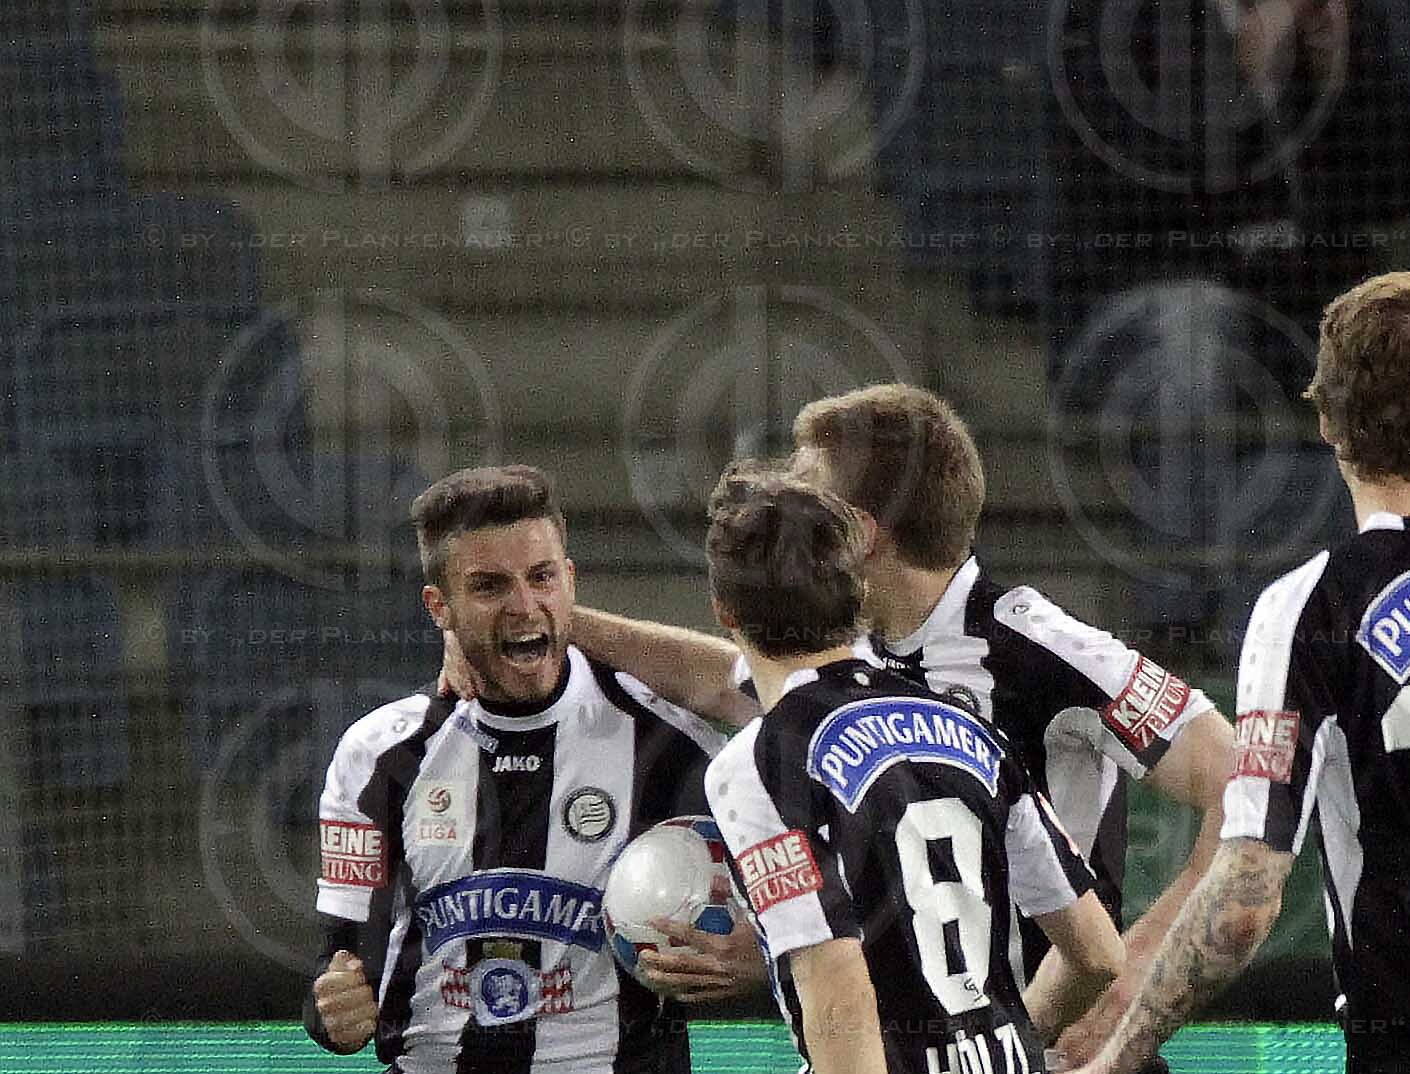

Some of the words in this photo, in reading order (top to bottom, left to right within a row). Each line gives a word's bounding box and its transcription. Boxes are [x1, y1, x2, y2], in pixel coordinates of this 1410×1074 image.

[491, 755, 541, 773] JAKO
[821, 712, 993, 788] PUNTIGAMER
[895, 797, 992, 1016] 8
